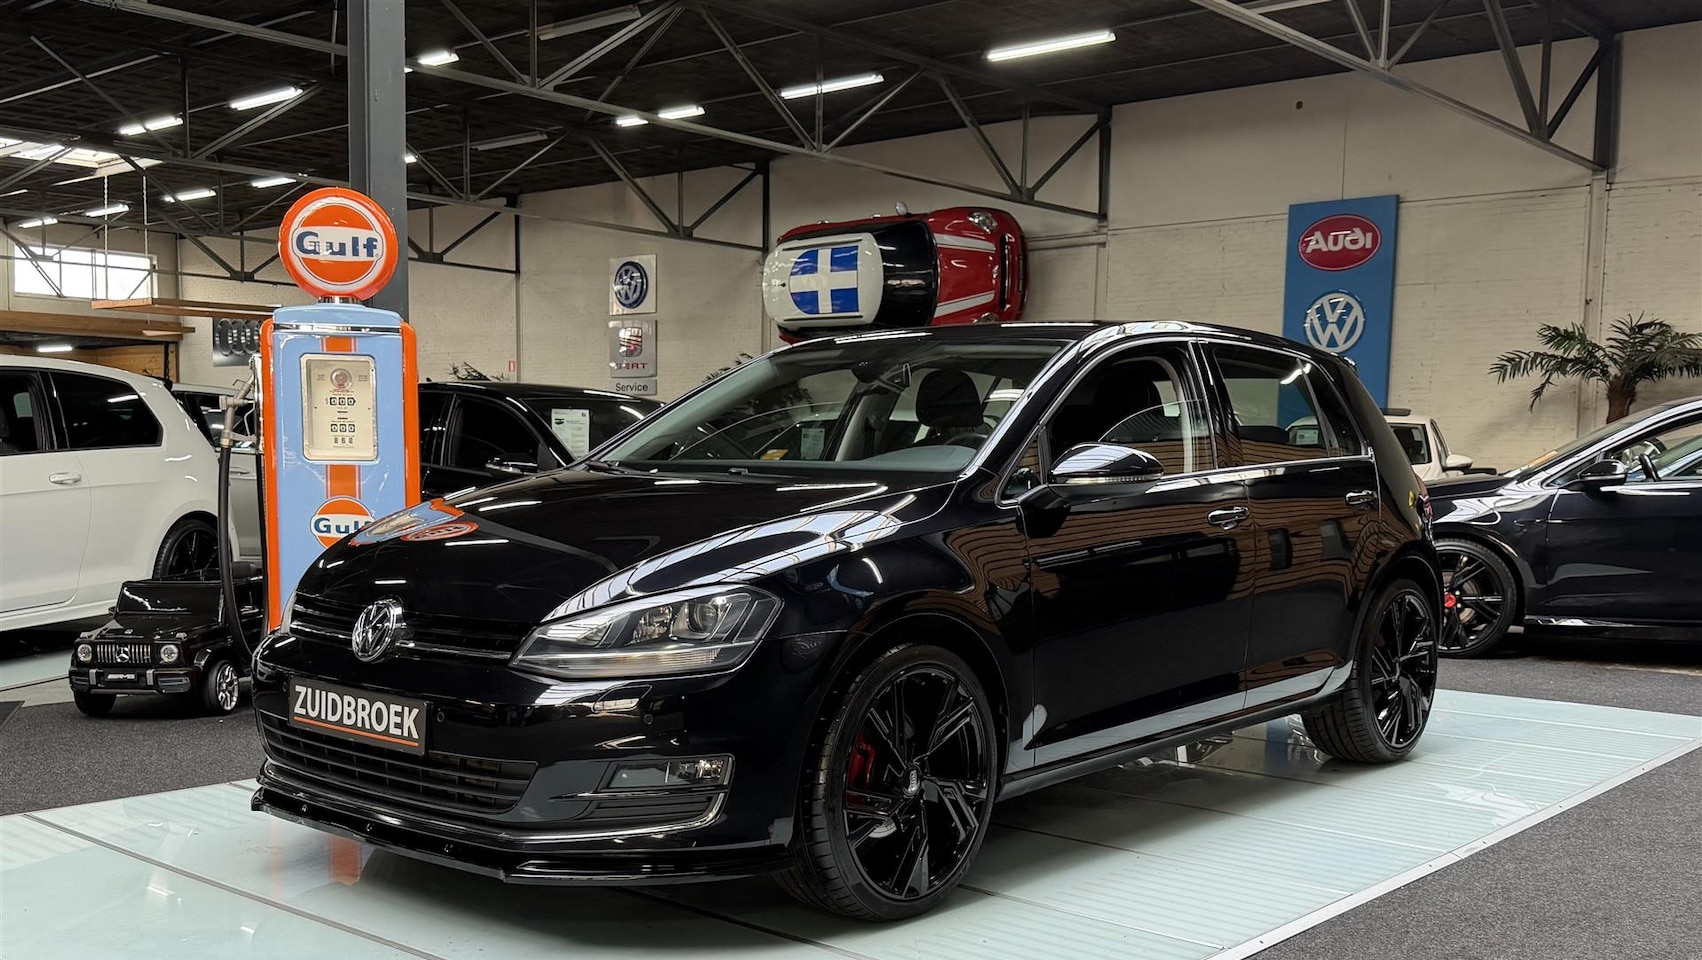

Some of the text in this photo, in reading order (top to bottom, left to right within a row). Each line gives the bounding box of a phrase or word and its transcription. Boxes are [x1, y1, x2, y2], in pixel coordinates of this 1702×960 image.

[296, 231, 378, 257] Gulf
[615, 382, 649, 392] Service
[314, 517, 371, 534] Gul
[294, 685, 420, 739] ZUIDBROEK
